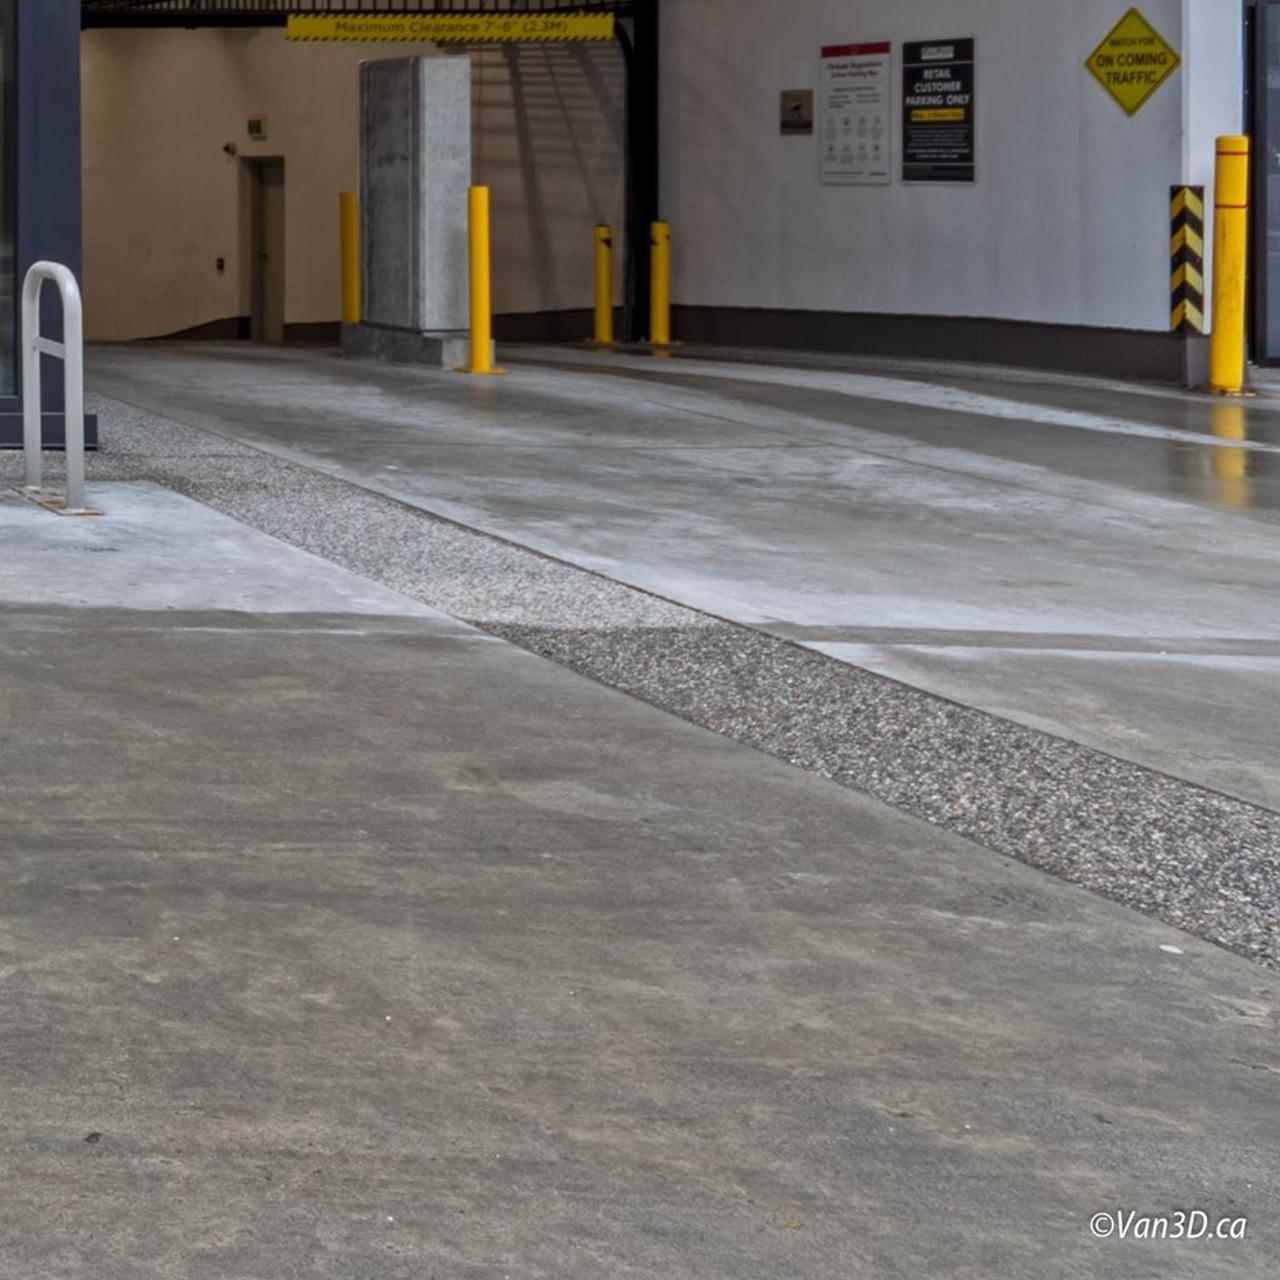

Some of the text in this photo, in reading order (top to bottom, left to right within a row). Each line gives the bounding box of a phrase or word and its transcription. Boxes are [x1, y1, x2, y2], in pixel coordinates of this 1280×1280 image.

[335, 21, 404, 33] Maximum
[409, 21, 479, 33] Clearance
[1096, 53, 1167, 68] ON COMING
[923, 68, 951, 80] RETAIL
[1106, 71, 1155, 84] TRAFFIC
[914, 81, 962, 93] CUSTOMER
[905, 94, 970, 107] PARKING ONLY
